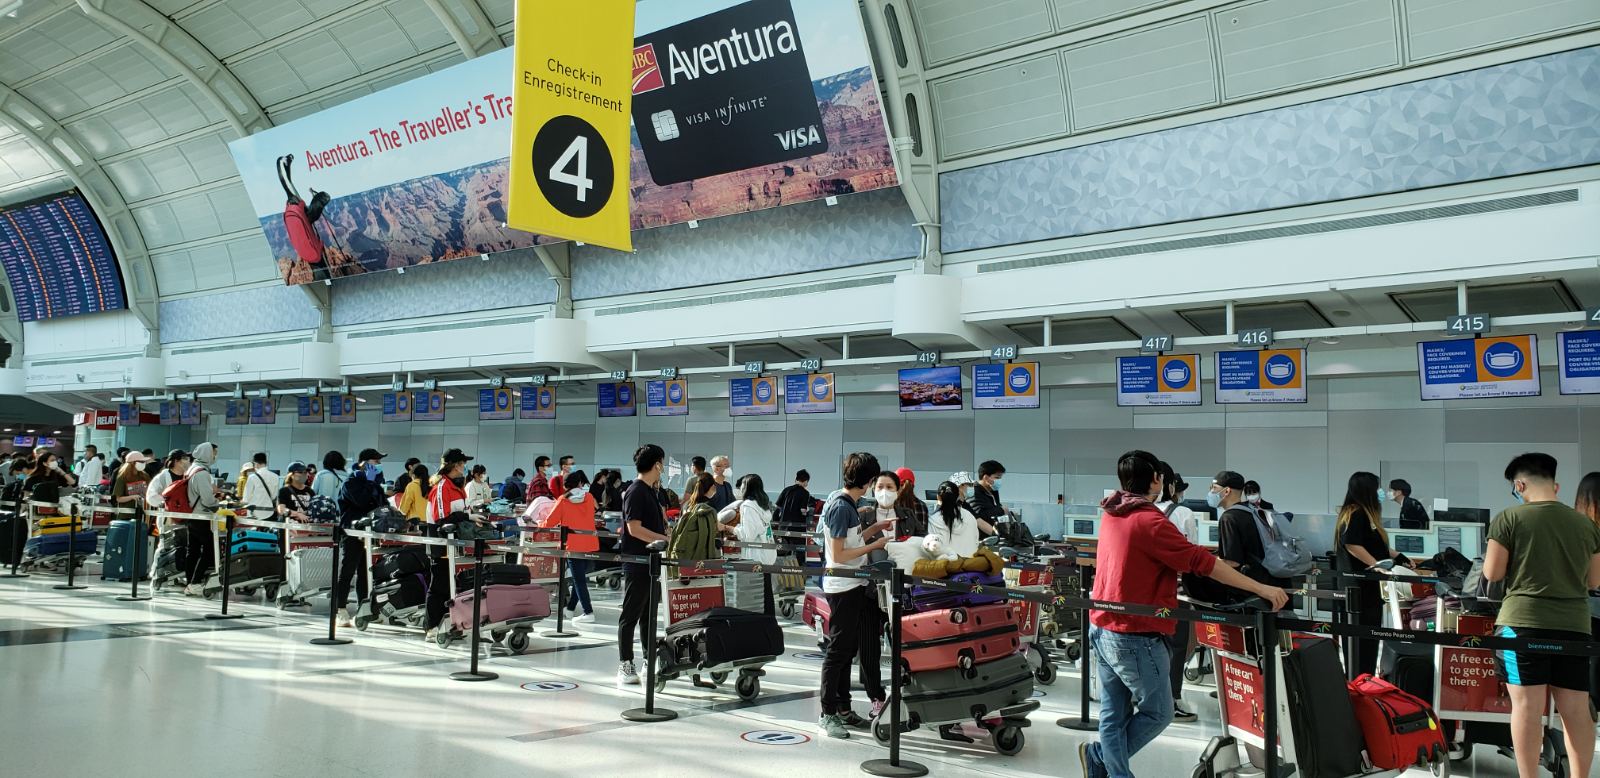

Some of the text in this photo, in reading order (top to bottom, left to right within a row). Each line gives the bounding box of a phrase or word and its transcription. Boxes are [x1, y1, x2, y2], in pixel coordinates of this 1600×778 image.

[668, 20, 797, 85] Aventura
[632, 50, 654, 70] IBC
[547, 58, 602, 87] Check-in
[524, 71, 623, 113] Enregistrement
[685, 113, 711, 126] VISA
[305, 93, 513, 172] Aventura. The Traveller's Tra
[773, 125, 821, 151] VISA
[549, 135, 593, 202] 4
[1452, 316, 1484, 332] 415
[1145, 337, 1167, 349] 417
[1242, 331, 1268, 344] 416
[919, 352, 937, 363] 419
[993, 346, 1014, 358] 418
[747, 363, 762, 372] 421
[801, 360, 819, 369] 420
[611, 371, 626, 379] 423
[661, 369, 676, 377] 422
[532, 375, 545, 384] 424
[97, 416, 117, 425] RELAY
[677, 593, 689, 601] free
[690, 592, 701, 600] cart
[680, 602, 689, 612] get
[690, 602, 700, 610] you
[1371, 629, 1415, 639] Toronto Pearson
[1527, 642, 1563, 651] bienvenue
[1450, 653, 1495, 665] A free ca
[1225, 663, 1254, 682] A free cart
[1450, 665, 1495, 678] to get yo
[1226, 676, 1254, 694] to get you
[1450, 676, 1480, 687] there.
[1227, 688, 1245, 703] there.
